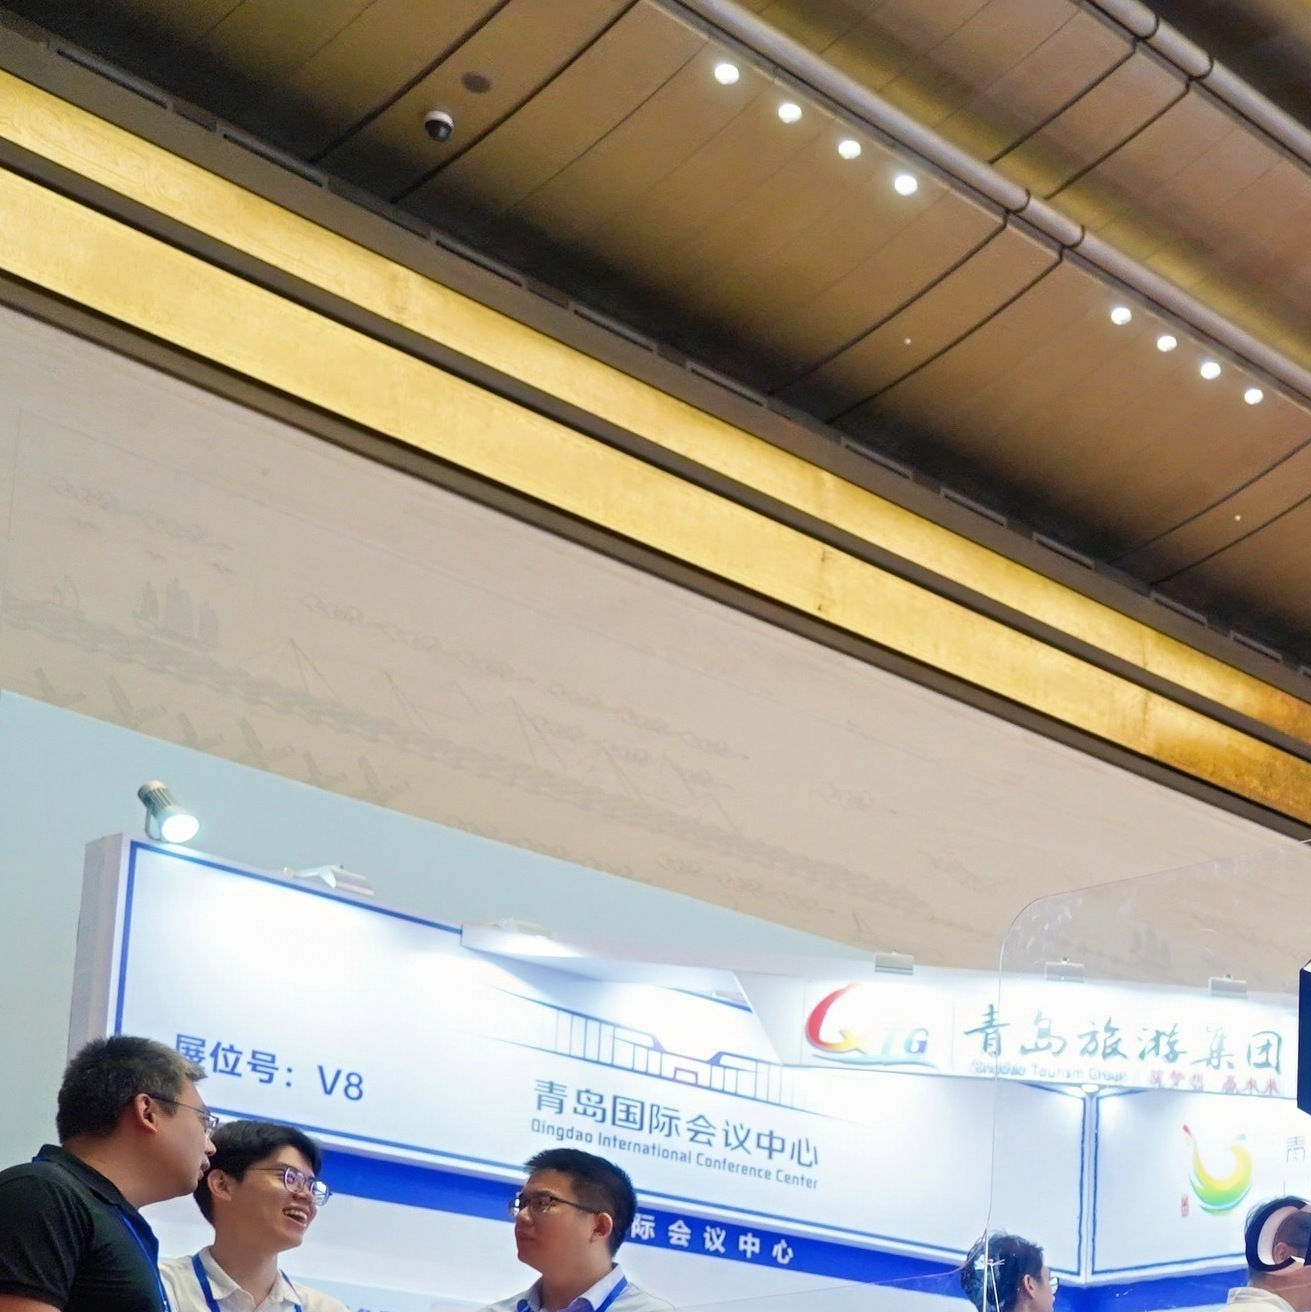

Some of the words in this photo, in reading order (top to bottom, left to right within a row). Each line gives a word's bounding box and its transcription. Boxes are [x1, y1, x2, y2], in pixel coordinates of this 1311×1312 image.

[963, 1003, 1285, 1076] 青岛旅游集团
[531, 1117, 594, 1143] Qingdao
[598, 1131, 693, 1165] International
[696, 1152, 772, 1181] Conference
[775, 1168, 819, 1190] Center
[532, 1079, 820, 1169] 青岛国际会议中心
[630, 1213, 795, 1265] 际会议中心
